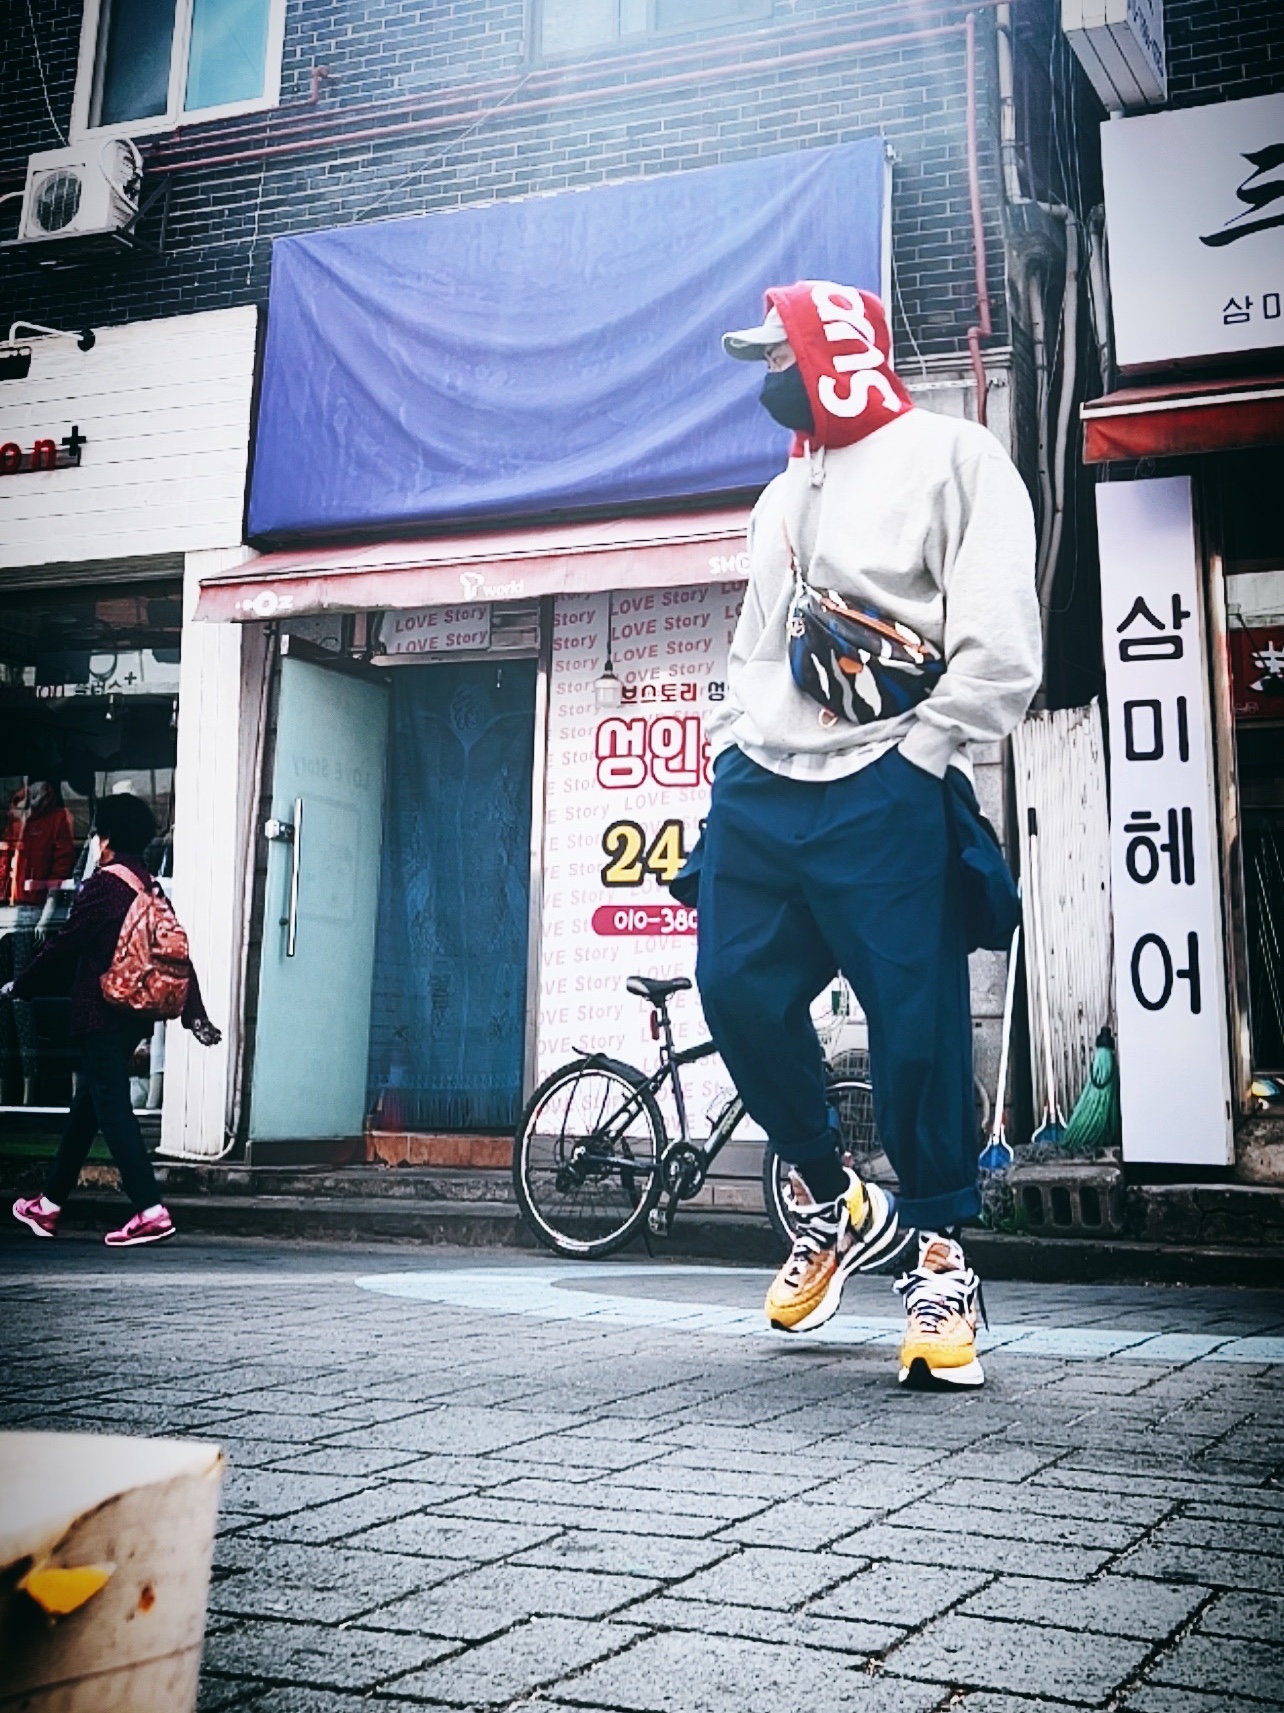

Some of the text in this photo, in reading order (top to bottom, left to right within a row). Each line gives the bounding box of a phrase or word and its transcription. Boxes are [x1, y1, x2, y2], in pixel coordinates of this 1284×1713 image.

[483, 580, 525, 597] world
[553, 610, 596, 627] Story
[661, 587, 709, 606] Story
[395, 606, 487, 633] LOVE Story
[446, 629, 488, 648] Story
[553, 634, 598, 651] Story
[611, 619, 657, 641] LOVE
[664, 612, 711, 631] Story
[555, 657, 599, 678] Story
[613, 644, 659, 664] LOVE
[666, 637, 713, 656] Story
[668, 660, 715, 679] Story
[565, 803, 609, 821] Story
[624, 790, 670, 812] LOVE
[1117, 593, 1201, 1014] 삼미헤어
[574, 946, 619, 963] Story
[575, 975, 621, 992] Story
[577, 1004, 623, 1022] Story
[579, 1034, 625, 1051] Story
